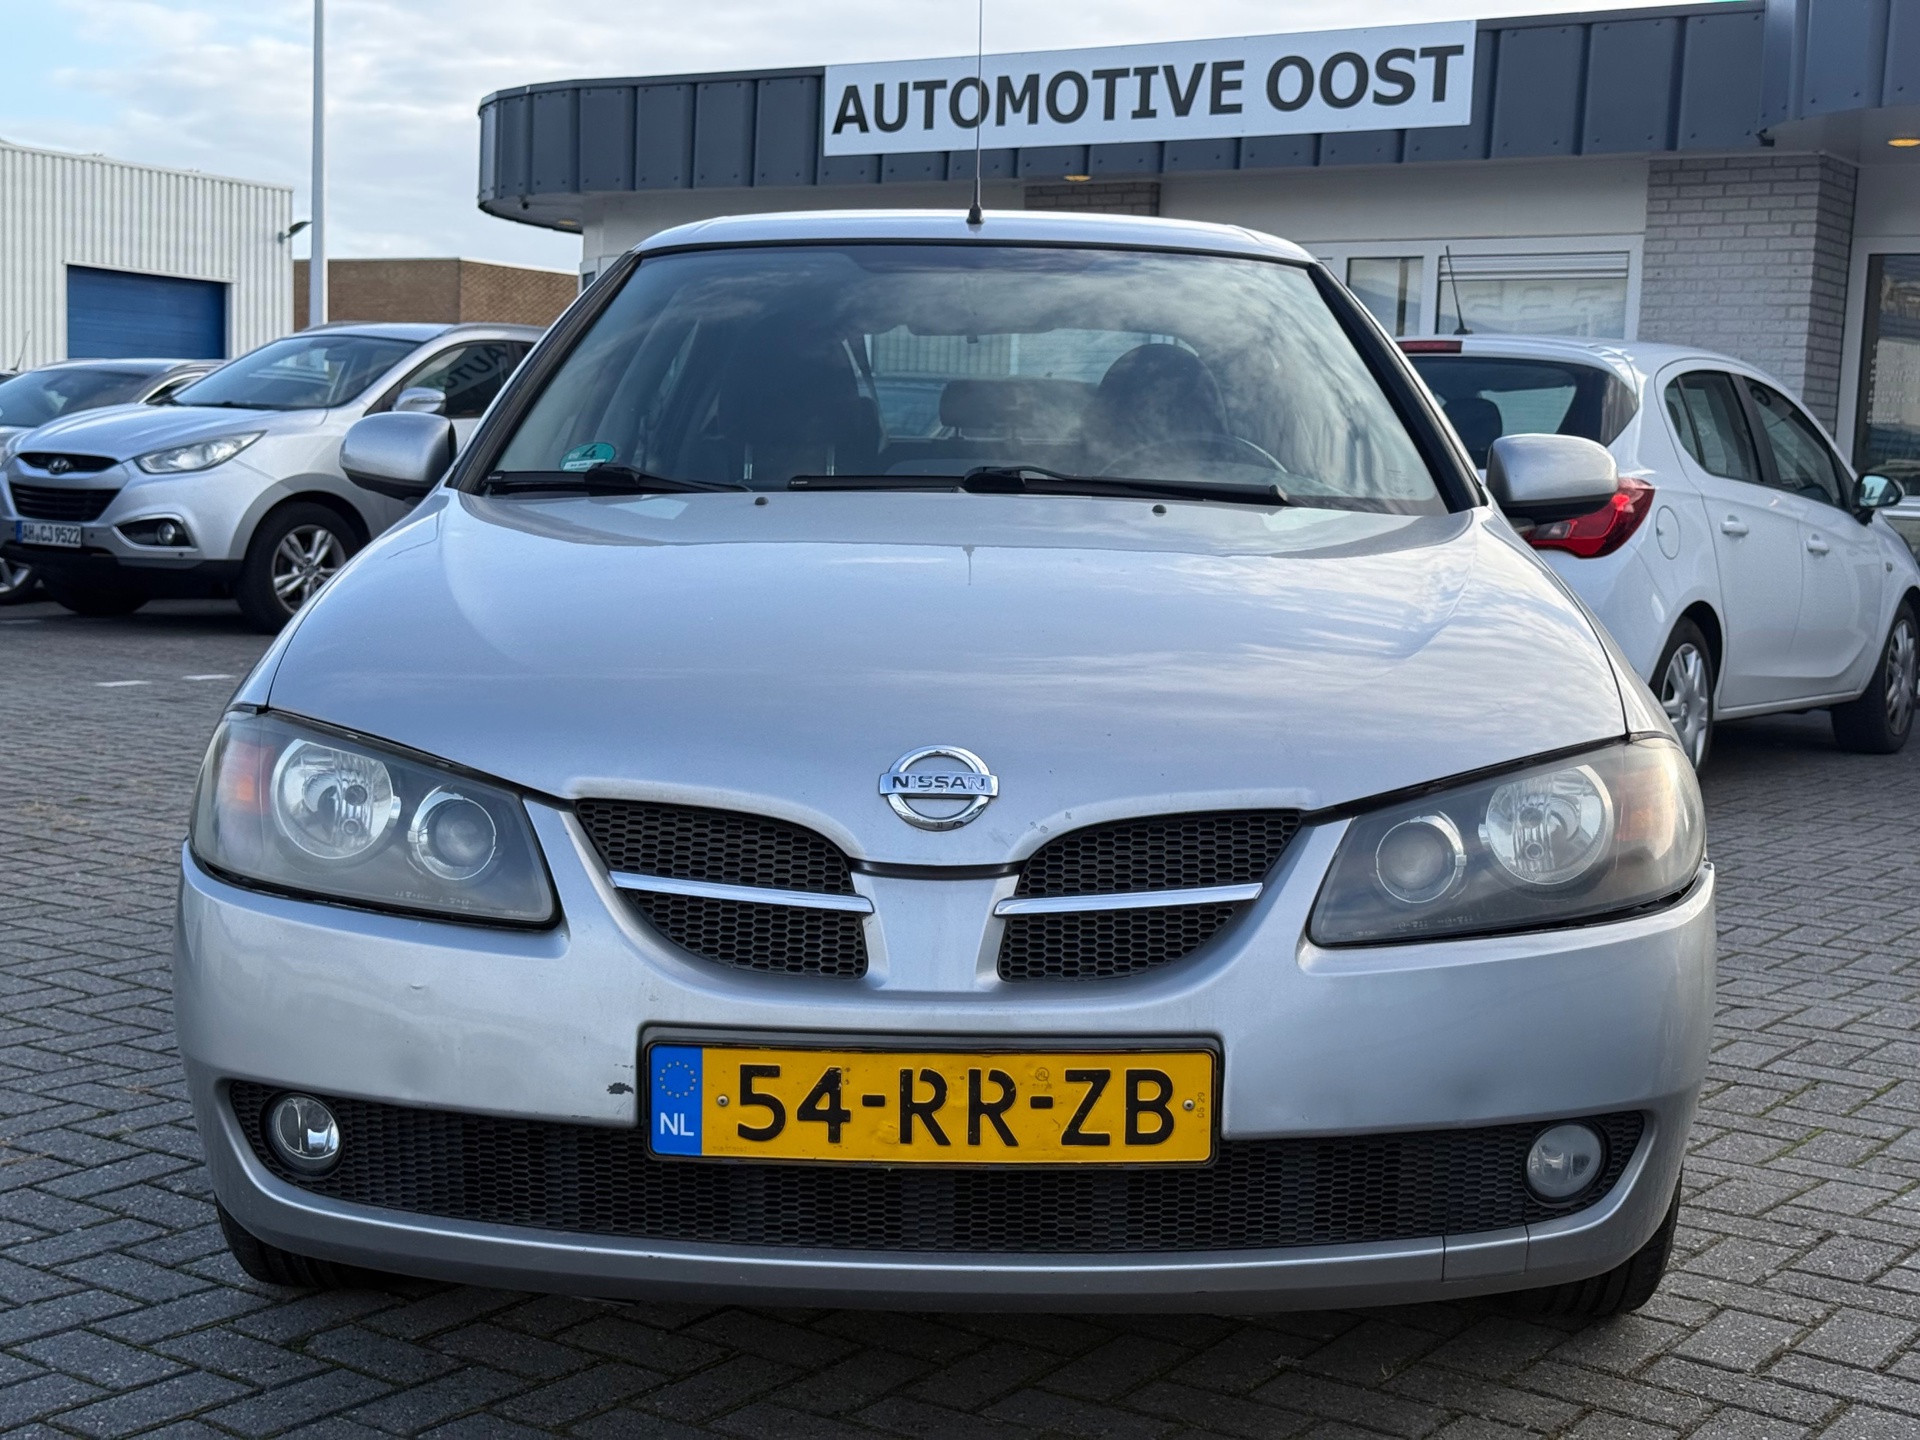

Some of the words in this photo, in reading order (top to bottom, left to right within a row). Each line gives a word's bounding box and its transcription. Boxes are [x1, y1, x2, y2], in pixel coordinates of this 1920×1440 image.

[832, 61, 1244, 135] AUTOMOTIVE
[1265, 46, 1465, 111] OOST
[581, 444, 598, 459] 4
[892, 775, 986, 791] NISSAN
[736, 1064, 1176, 1146] 54-RR-ZB
[659, 1112, 695, 1137] NL
